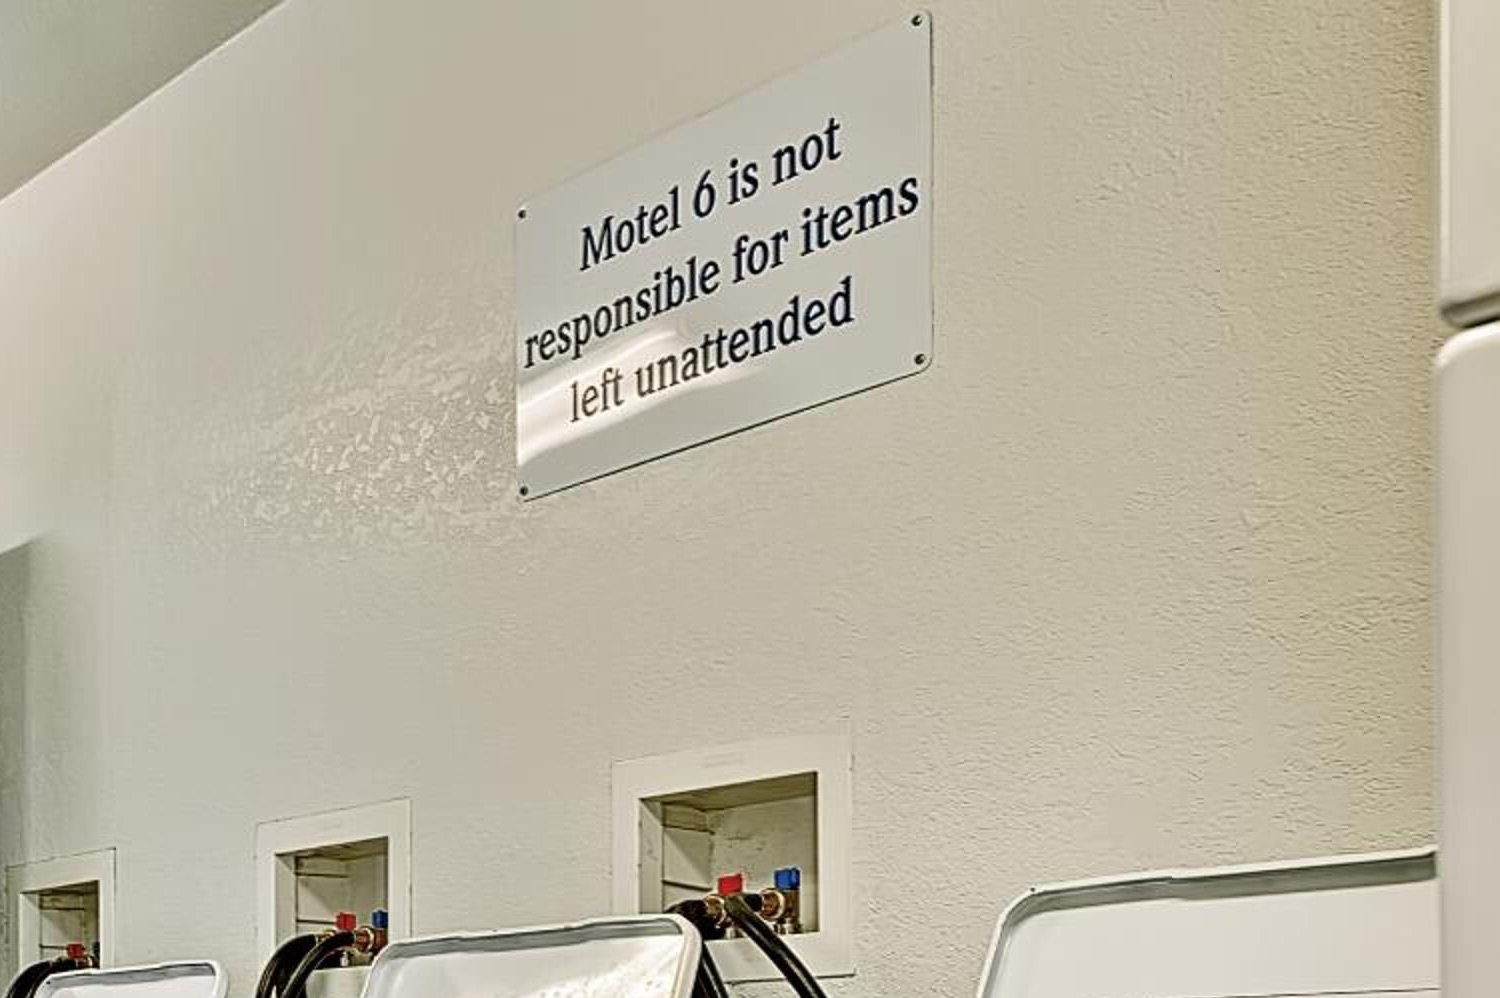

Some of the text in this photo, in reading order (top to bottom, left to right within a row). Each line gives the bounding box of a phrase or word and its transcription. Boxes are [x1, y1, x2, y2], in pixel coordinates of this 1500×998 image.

[579, 117, 842, 272] Motel 6 is not
[523, 176, 920, 370] responsible for items
[569, 276, 855, 423] left unattended
